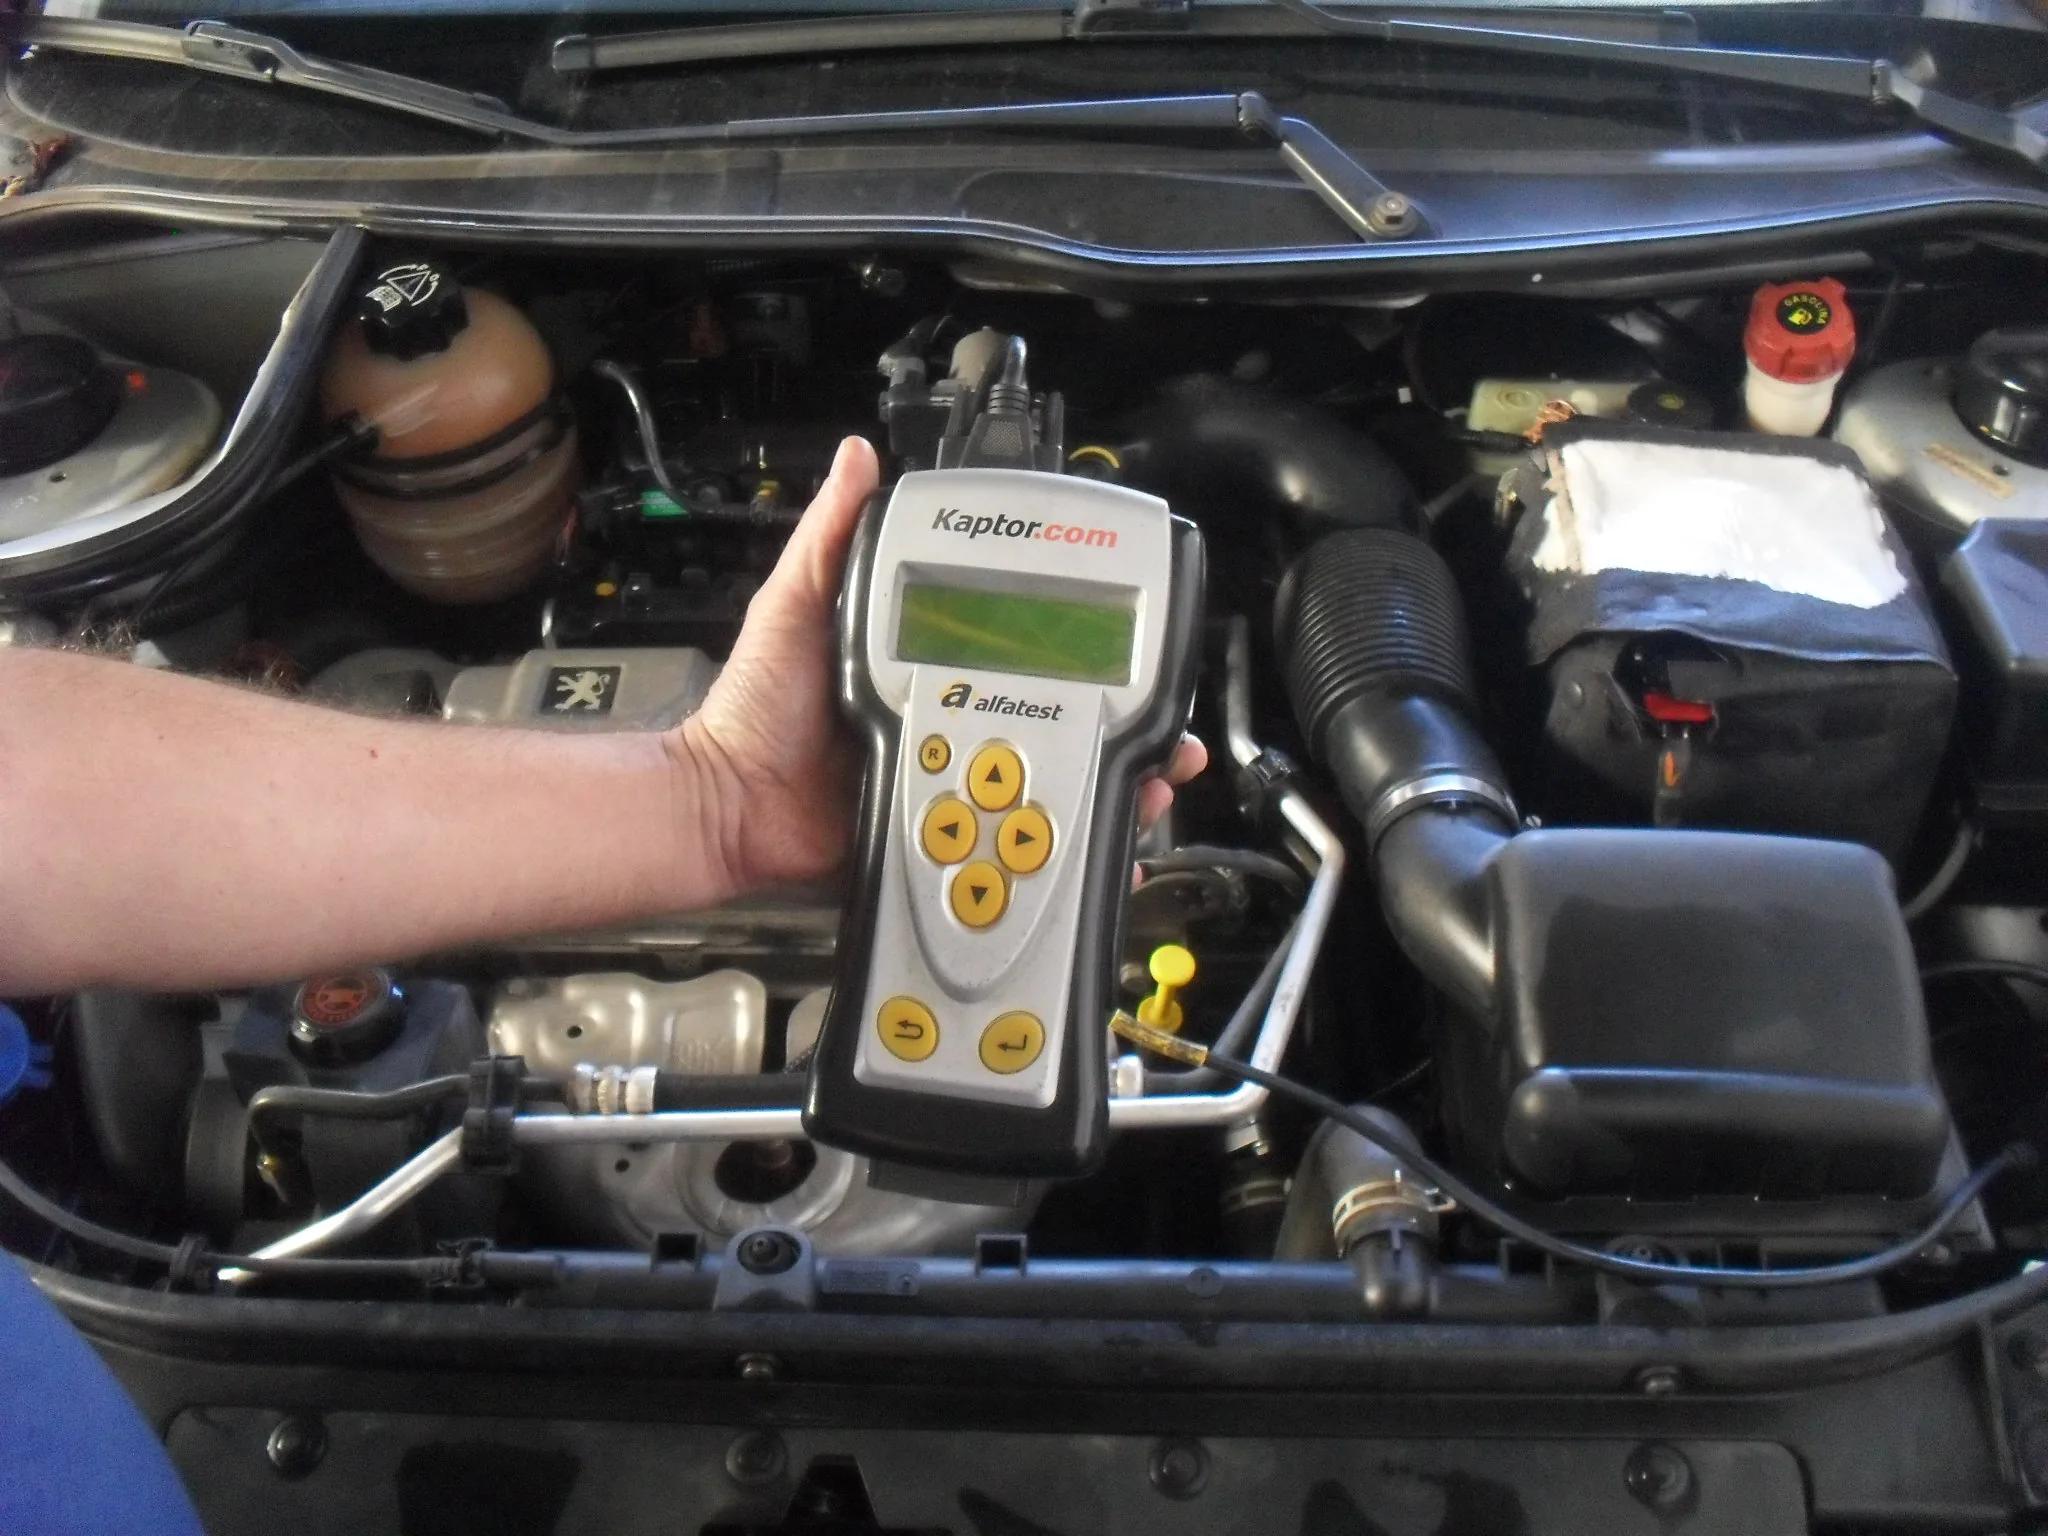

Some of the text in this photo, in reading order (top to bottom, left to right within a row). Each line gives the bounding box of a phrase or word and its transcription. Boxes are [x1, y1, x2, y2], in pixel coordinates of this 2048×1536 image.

[931, 507, 1119, 548] Kaptor.com
[974, 695, 1063, 721] alfatest
[928, 748, 939, 760] R
